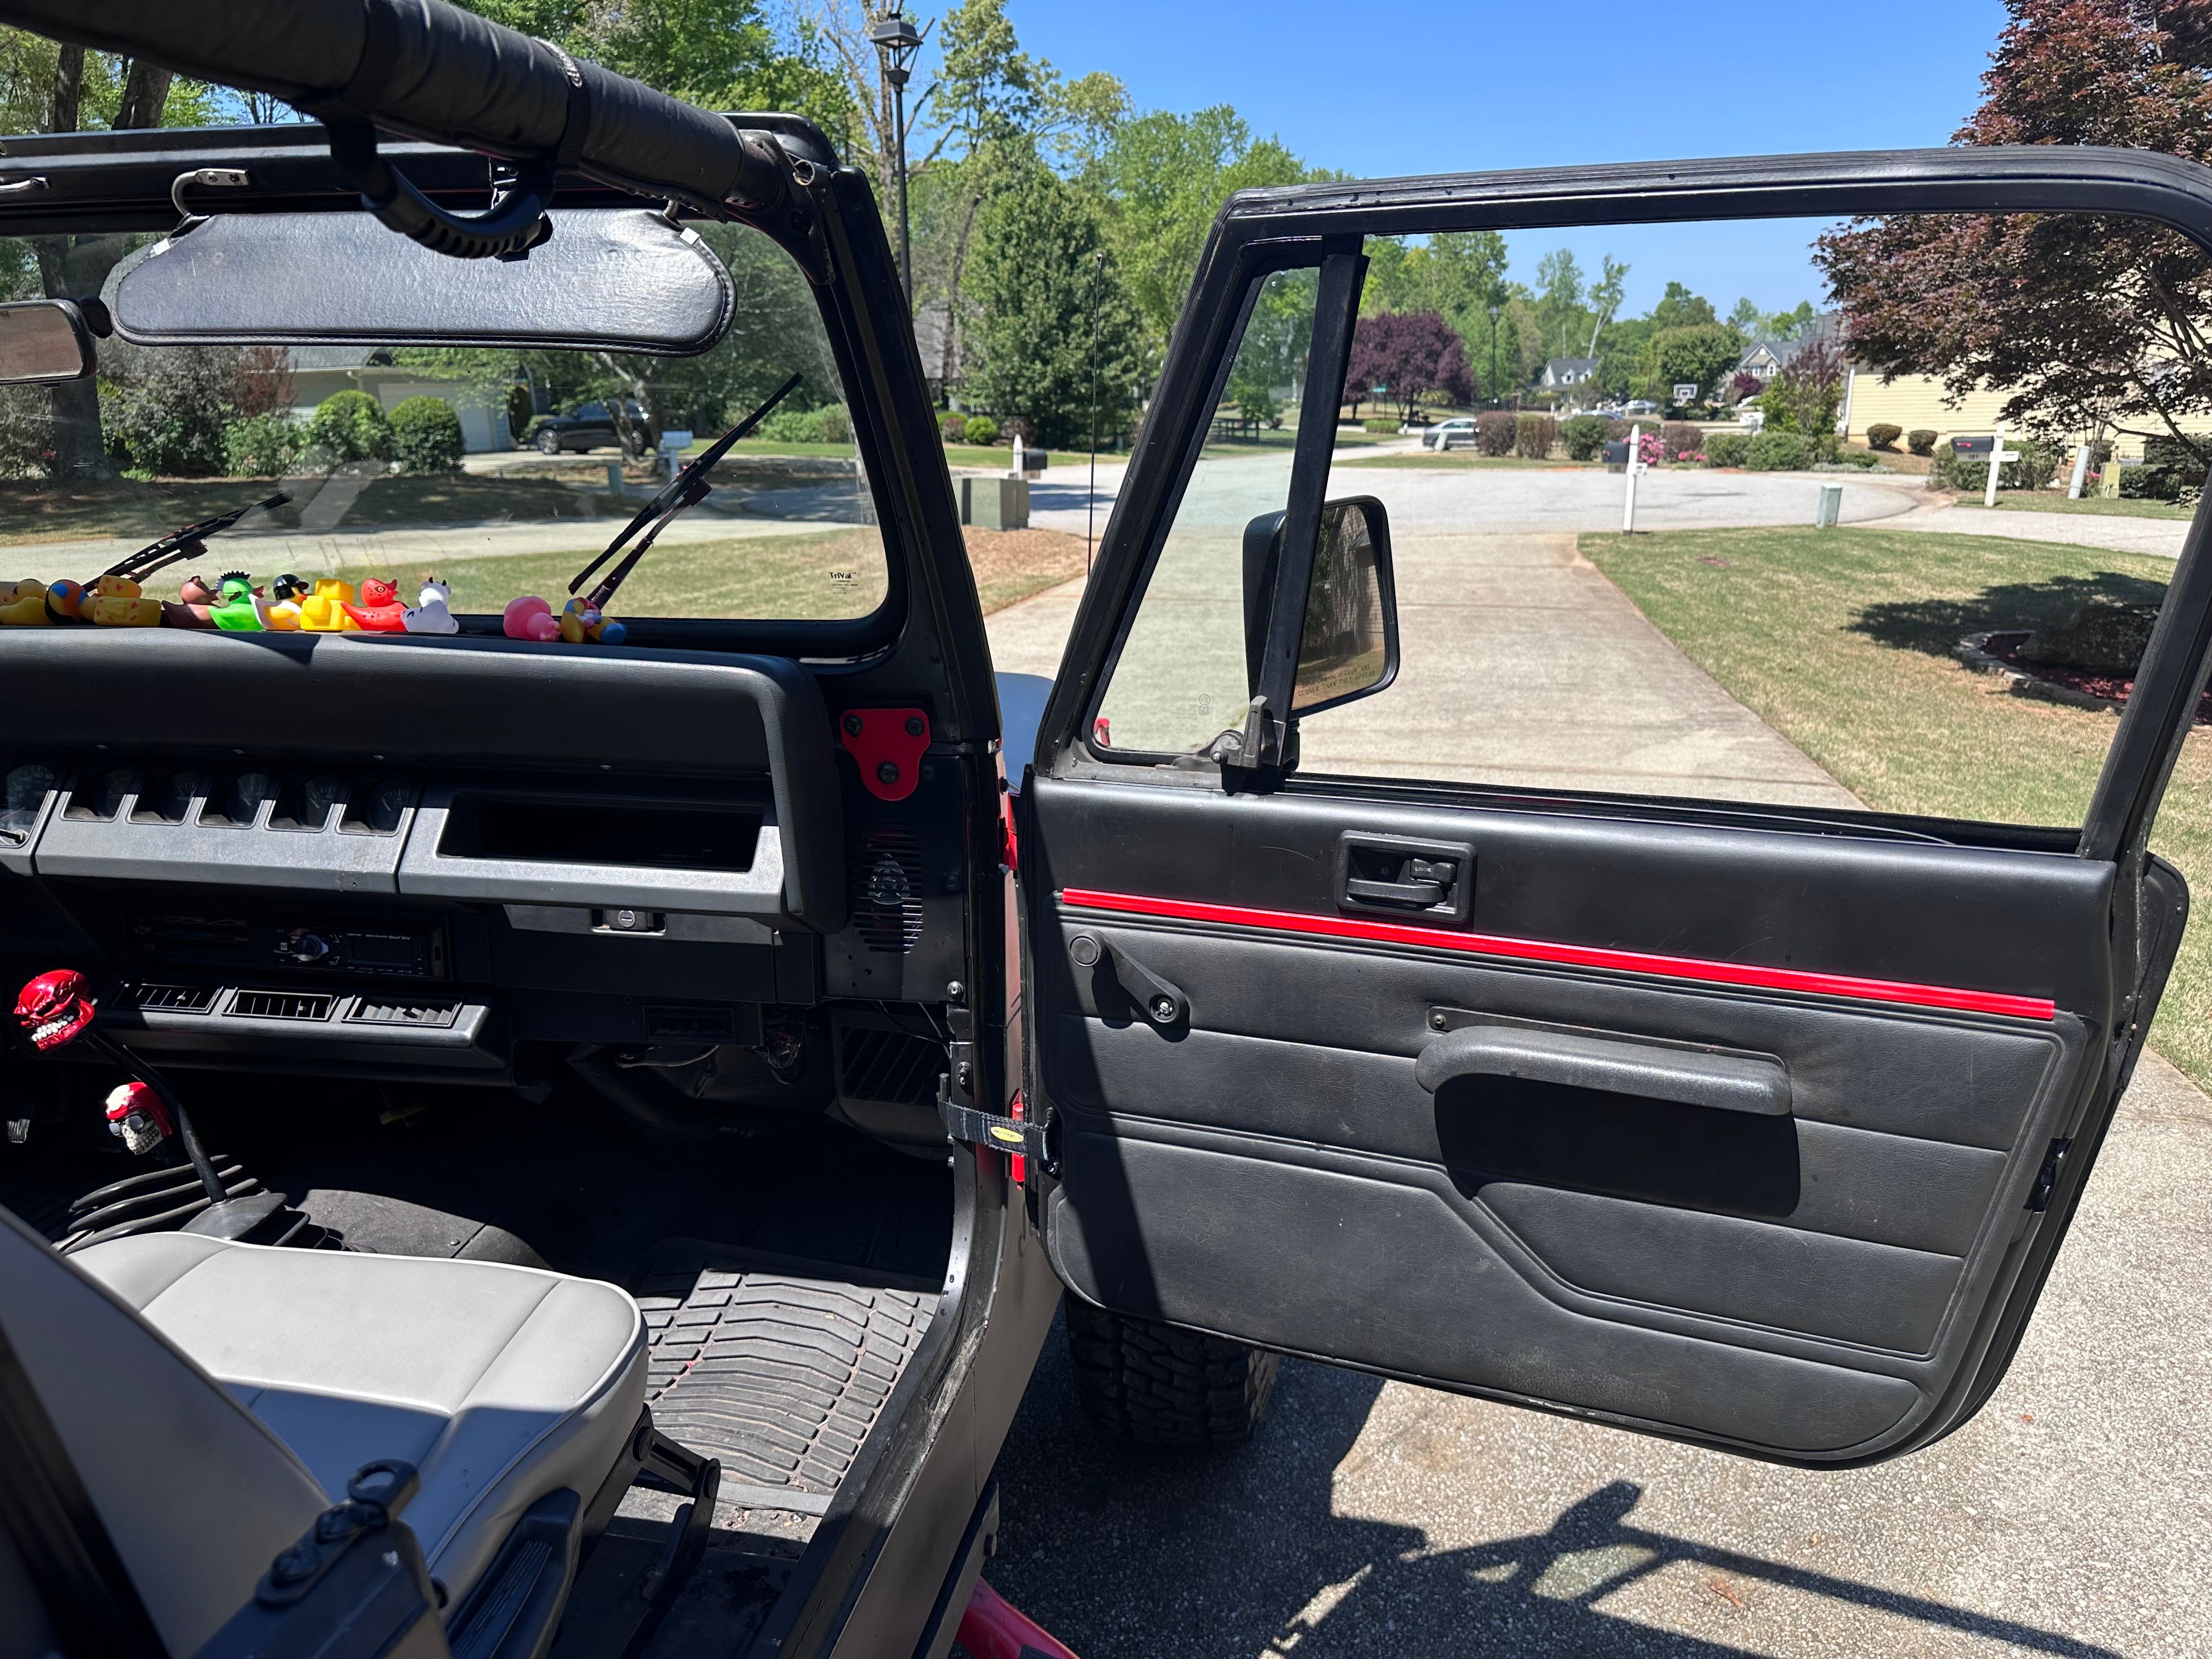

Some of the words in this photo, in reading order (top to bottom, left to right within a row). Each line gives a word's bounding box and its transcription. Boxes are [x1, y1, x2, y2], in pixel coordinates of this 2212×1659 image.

[1298, 686, 1319, 696] CLOSER
[1323, 681, 1336, 690] THAN
[1356, 670, 1375, 681] APPEAR
[1302, 676, 1327, 687] OBJECTS
[1339, 668, 1357, 677] MIRROR
